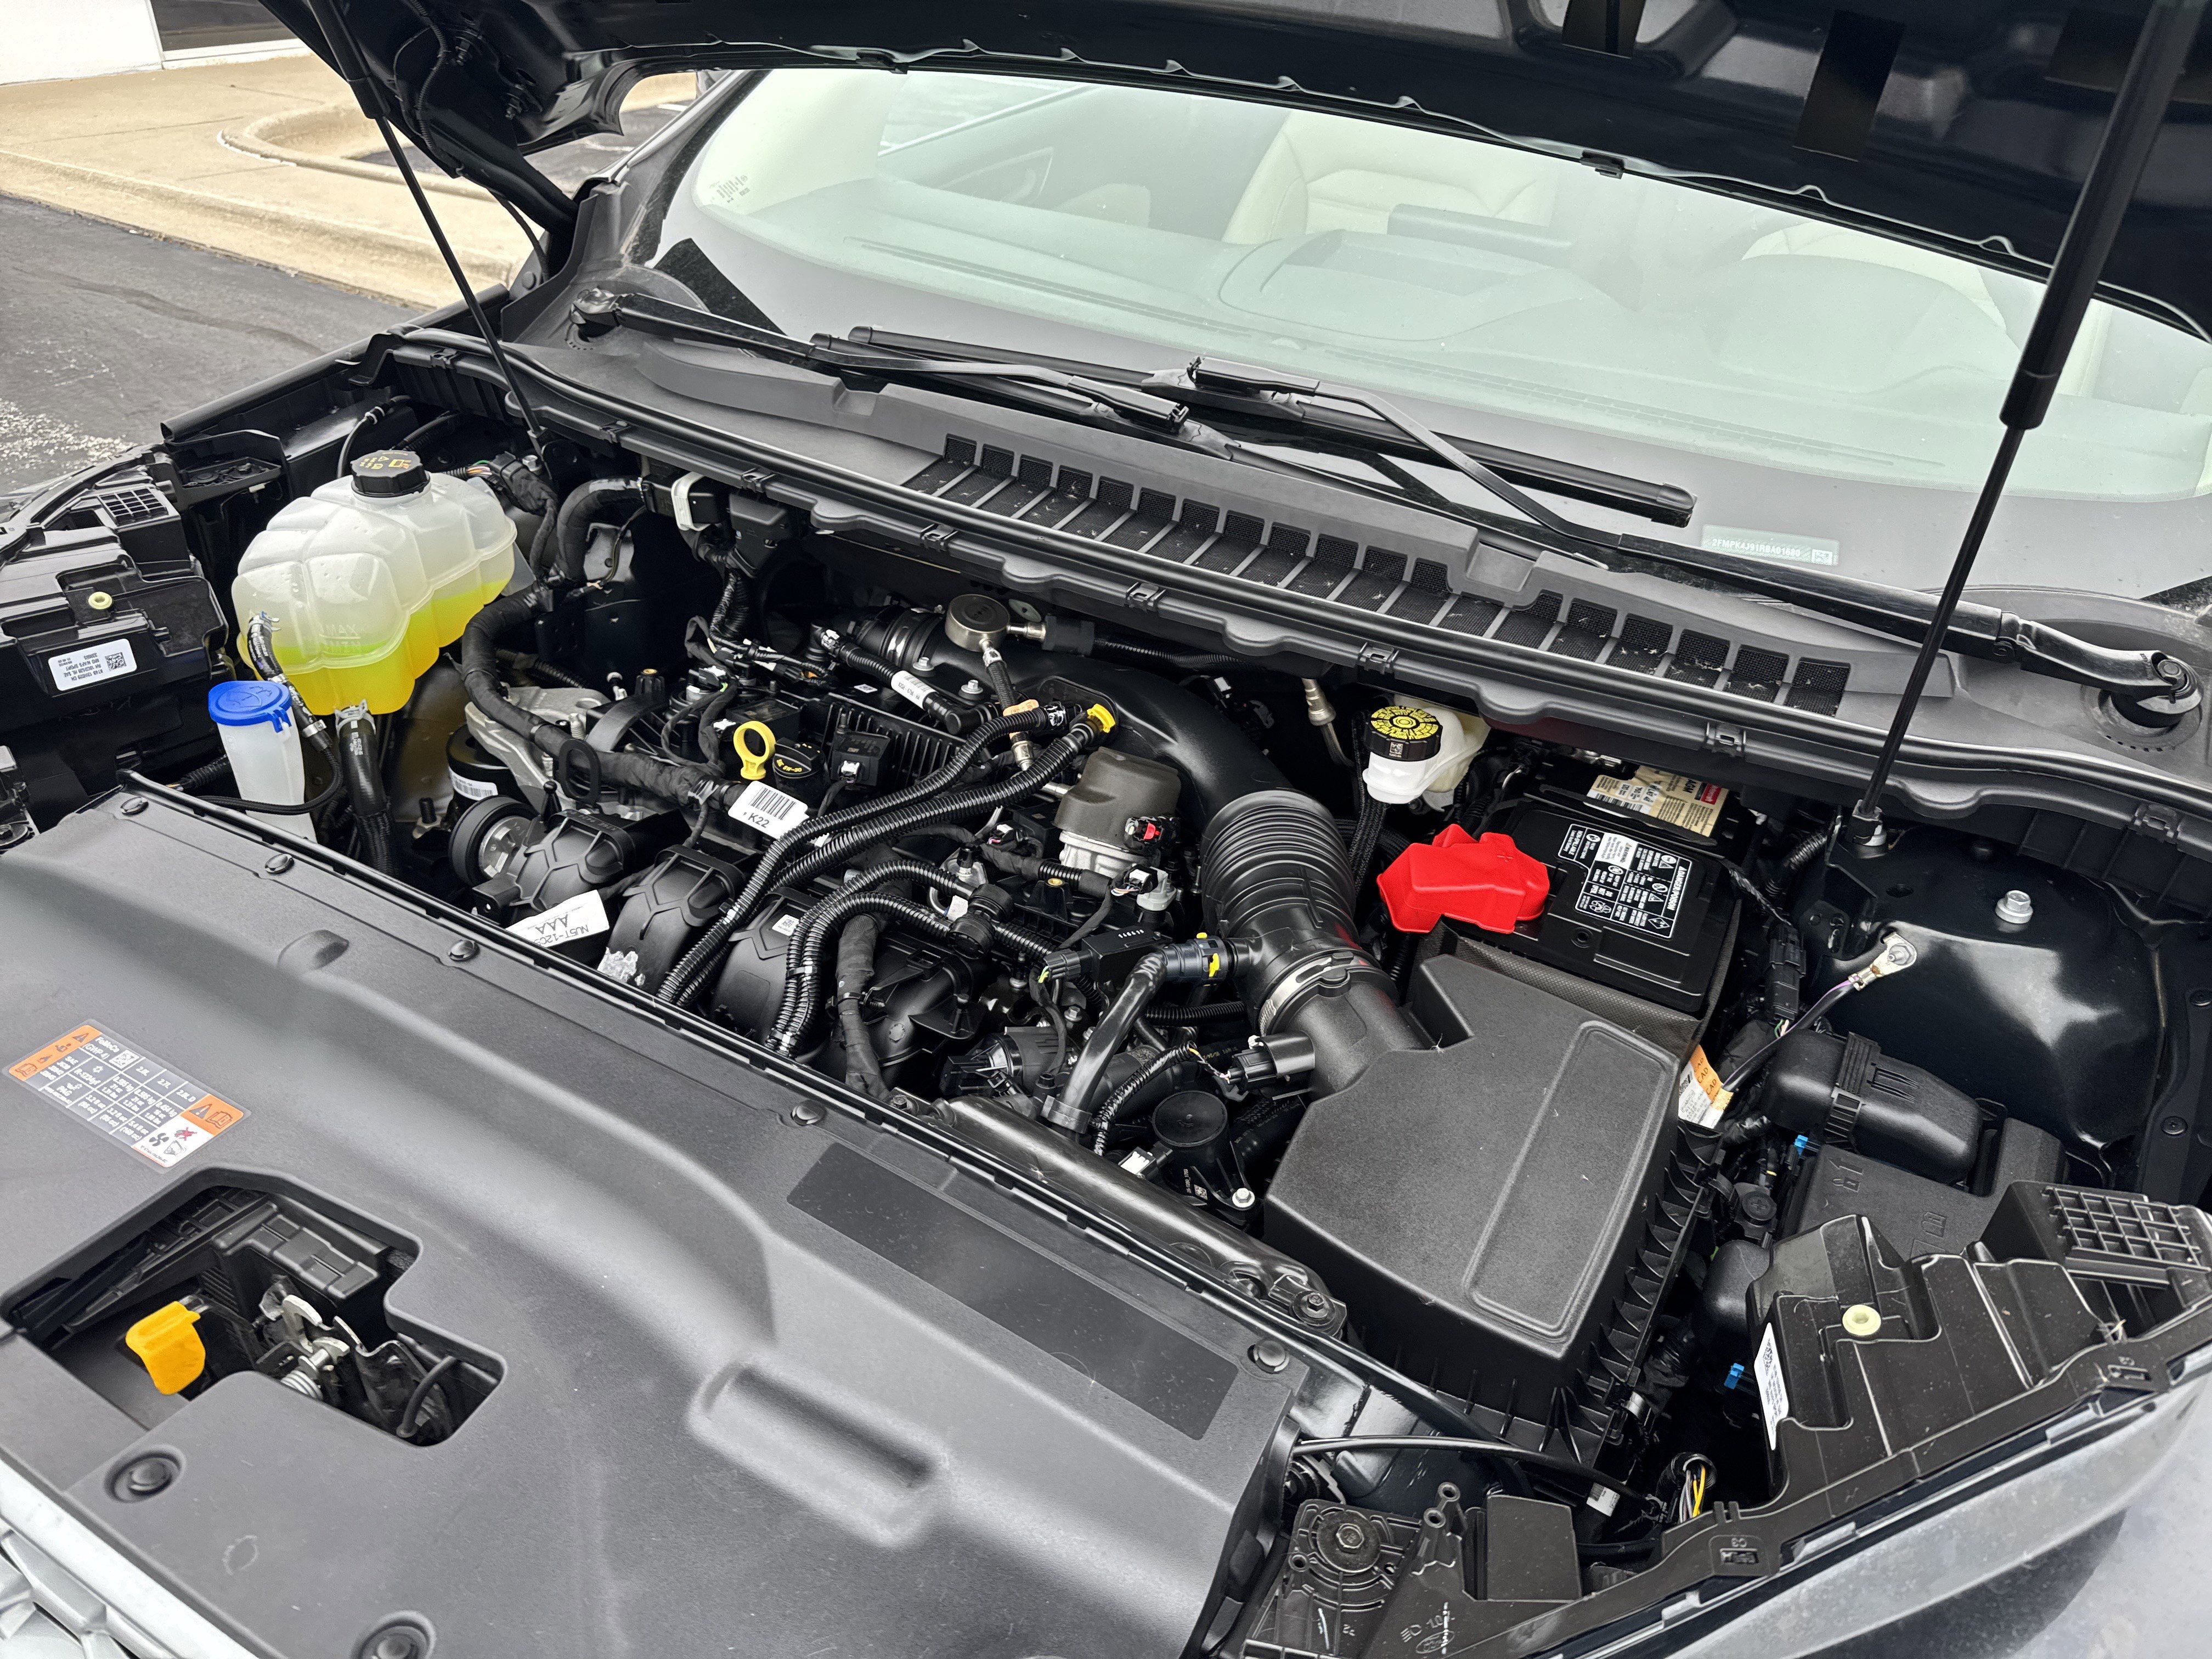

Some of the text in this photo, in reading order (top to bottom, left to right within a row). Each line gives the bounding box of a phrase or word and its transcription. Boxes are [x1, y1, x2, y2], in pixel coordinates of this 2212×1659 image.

[1682, 778, 1697, 793] AGM
[748, 812, 769, 828] K22
[535, 914, 568, 934] AAA
[1697, 1068, 1708, 1084] CAD
[57, 1086, 72, 1096] PAG
[1706, 1079, 1717, 1095] CAD
[1731, 1538, 1747, 1547] C3
